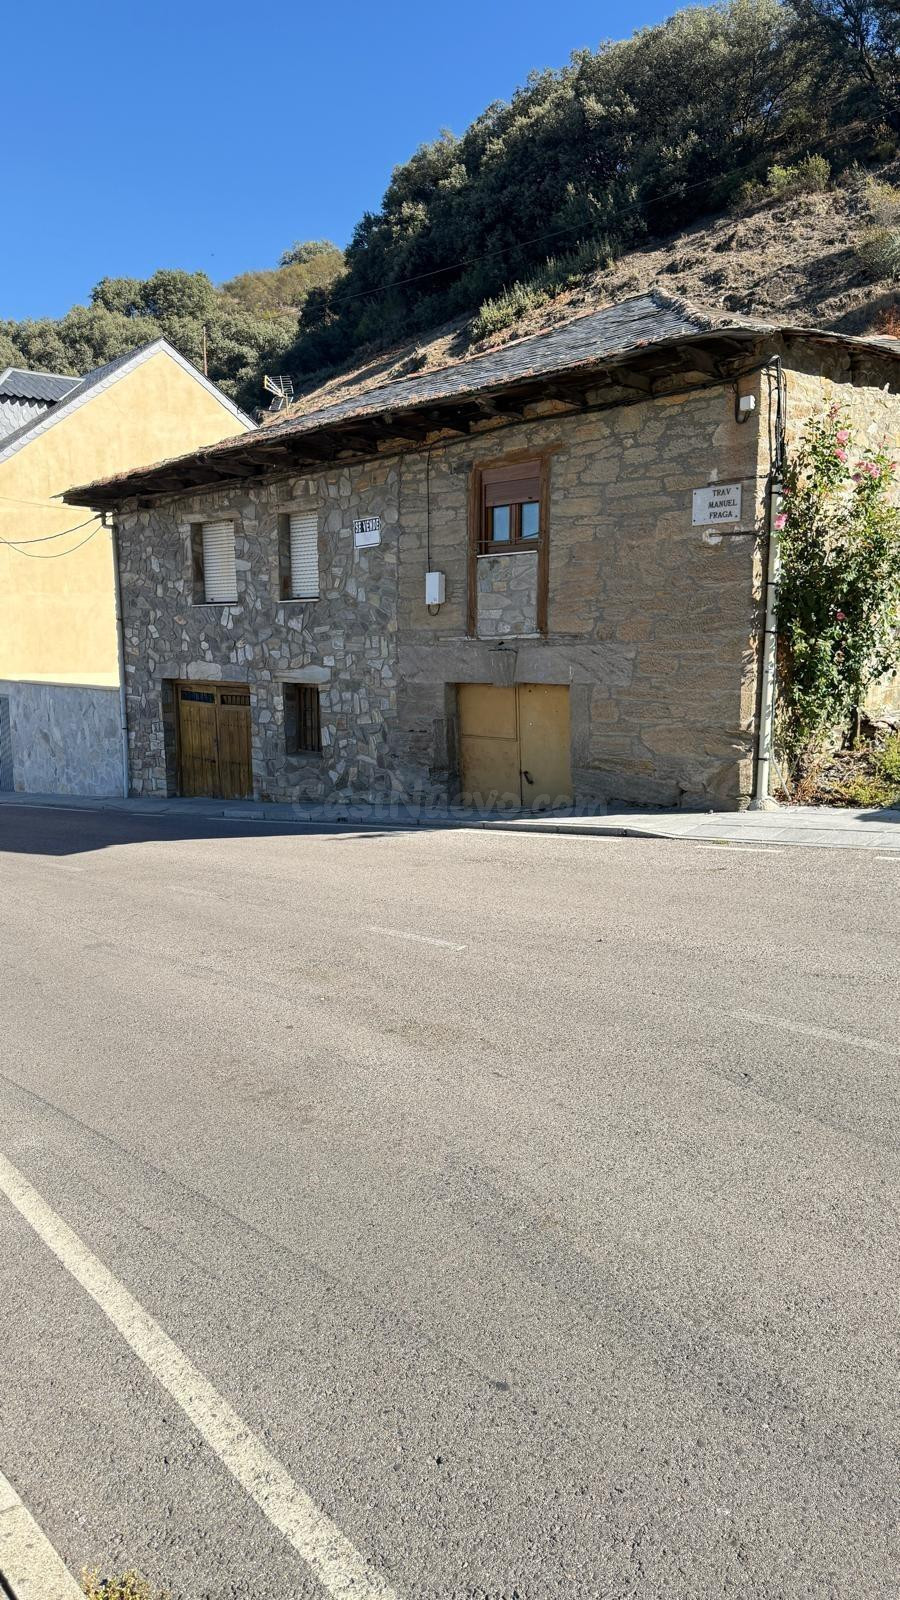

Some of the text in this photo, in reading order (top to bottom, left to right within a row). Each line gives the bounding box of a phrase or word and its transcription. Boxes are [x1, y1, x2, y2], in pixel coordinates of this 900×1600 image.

[713, 488, 732, 497] TRAV
[708, 499, 737, 508] MANUEL
[709, 511, 732, 519] FRAGA
[355, 519, 379, 533] SE VENDE
